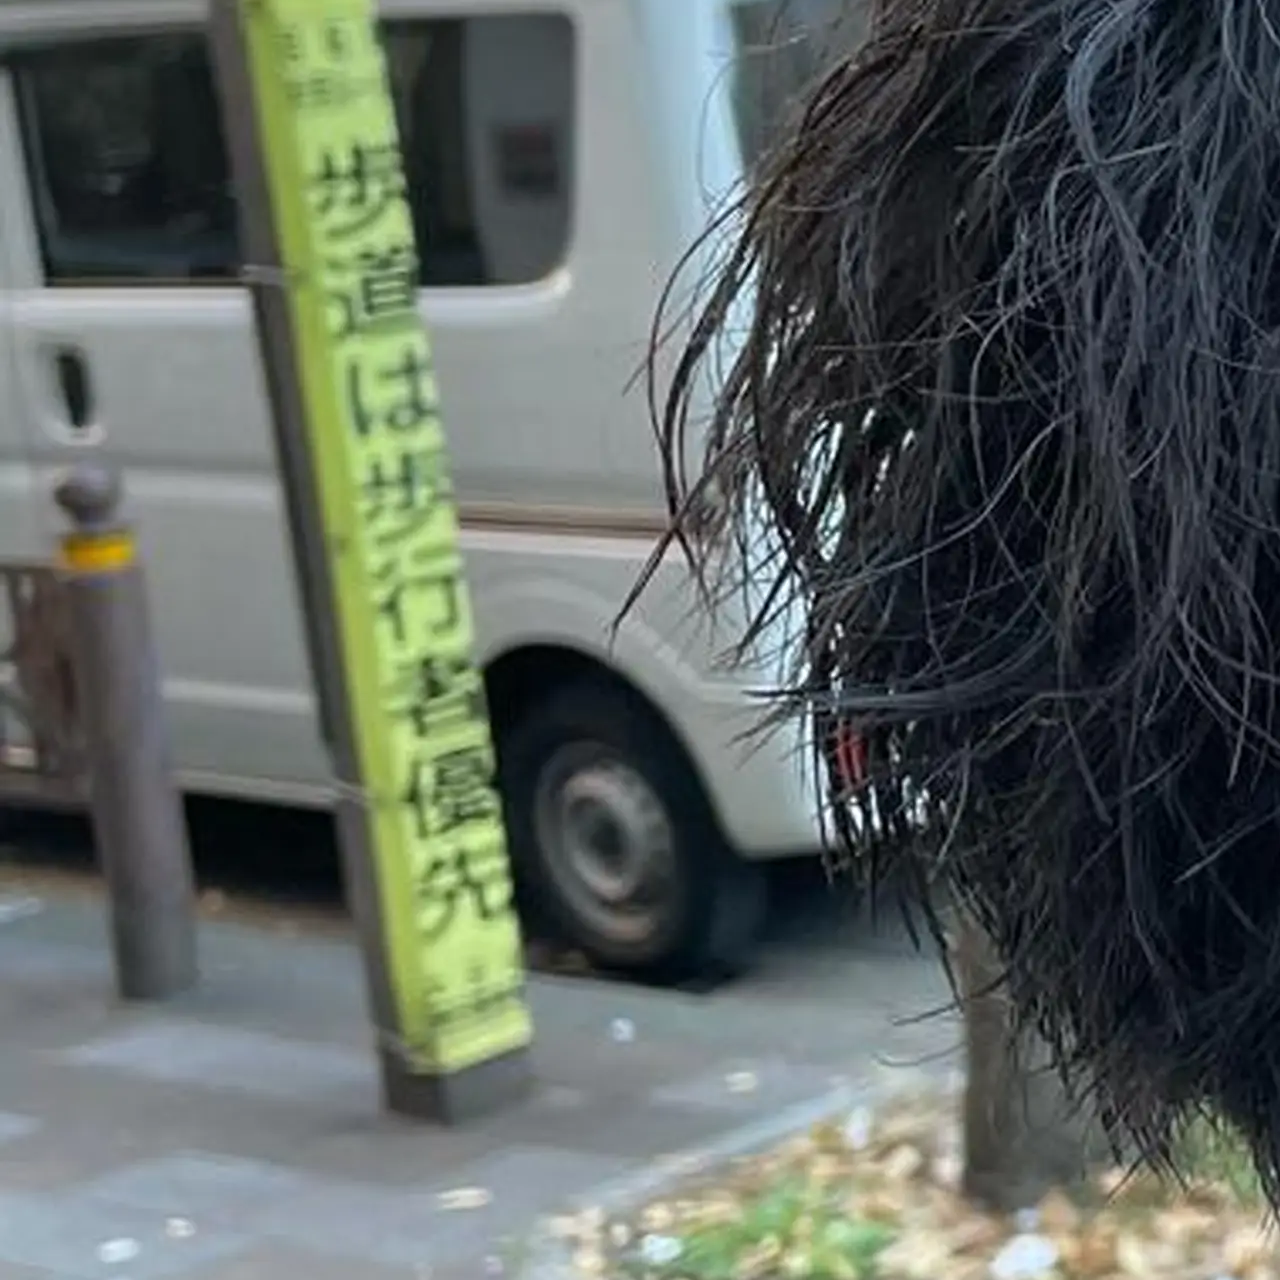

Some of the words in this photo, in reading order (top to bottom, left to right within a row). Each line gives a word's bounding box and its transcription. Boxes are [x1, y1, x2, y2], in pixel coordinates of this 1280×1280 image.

[314, 142, 514, 942] 歩道は歩行者優先
